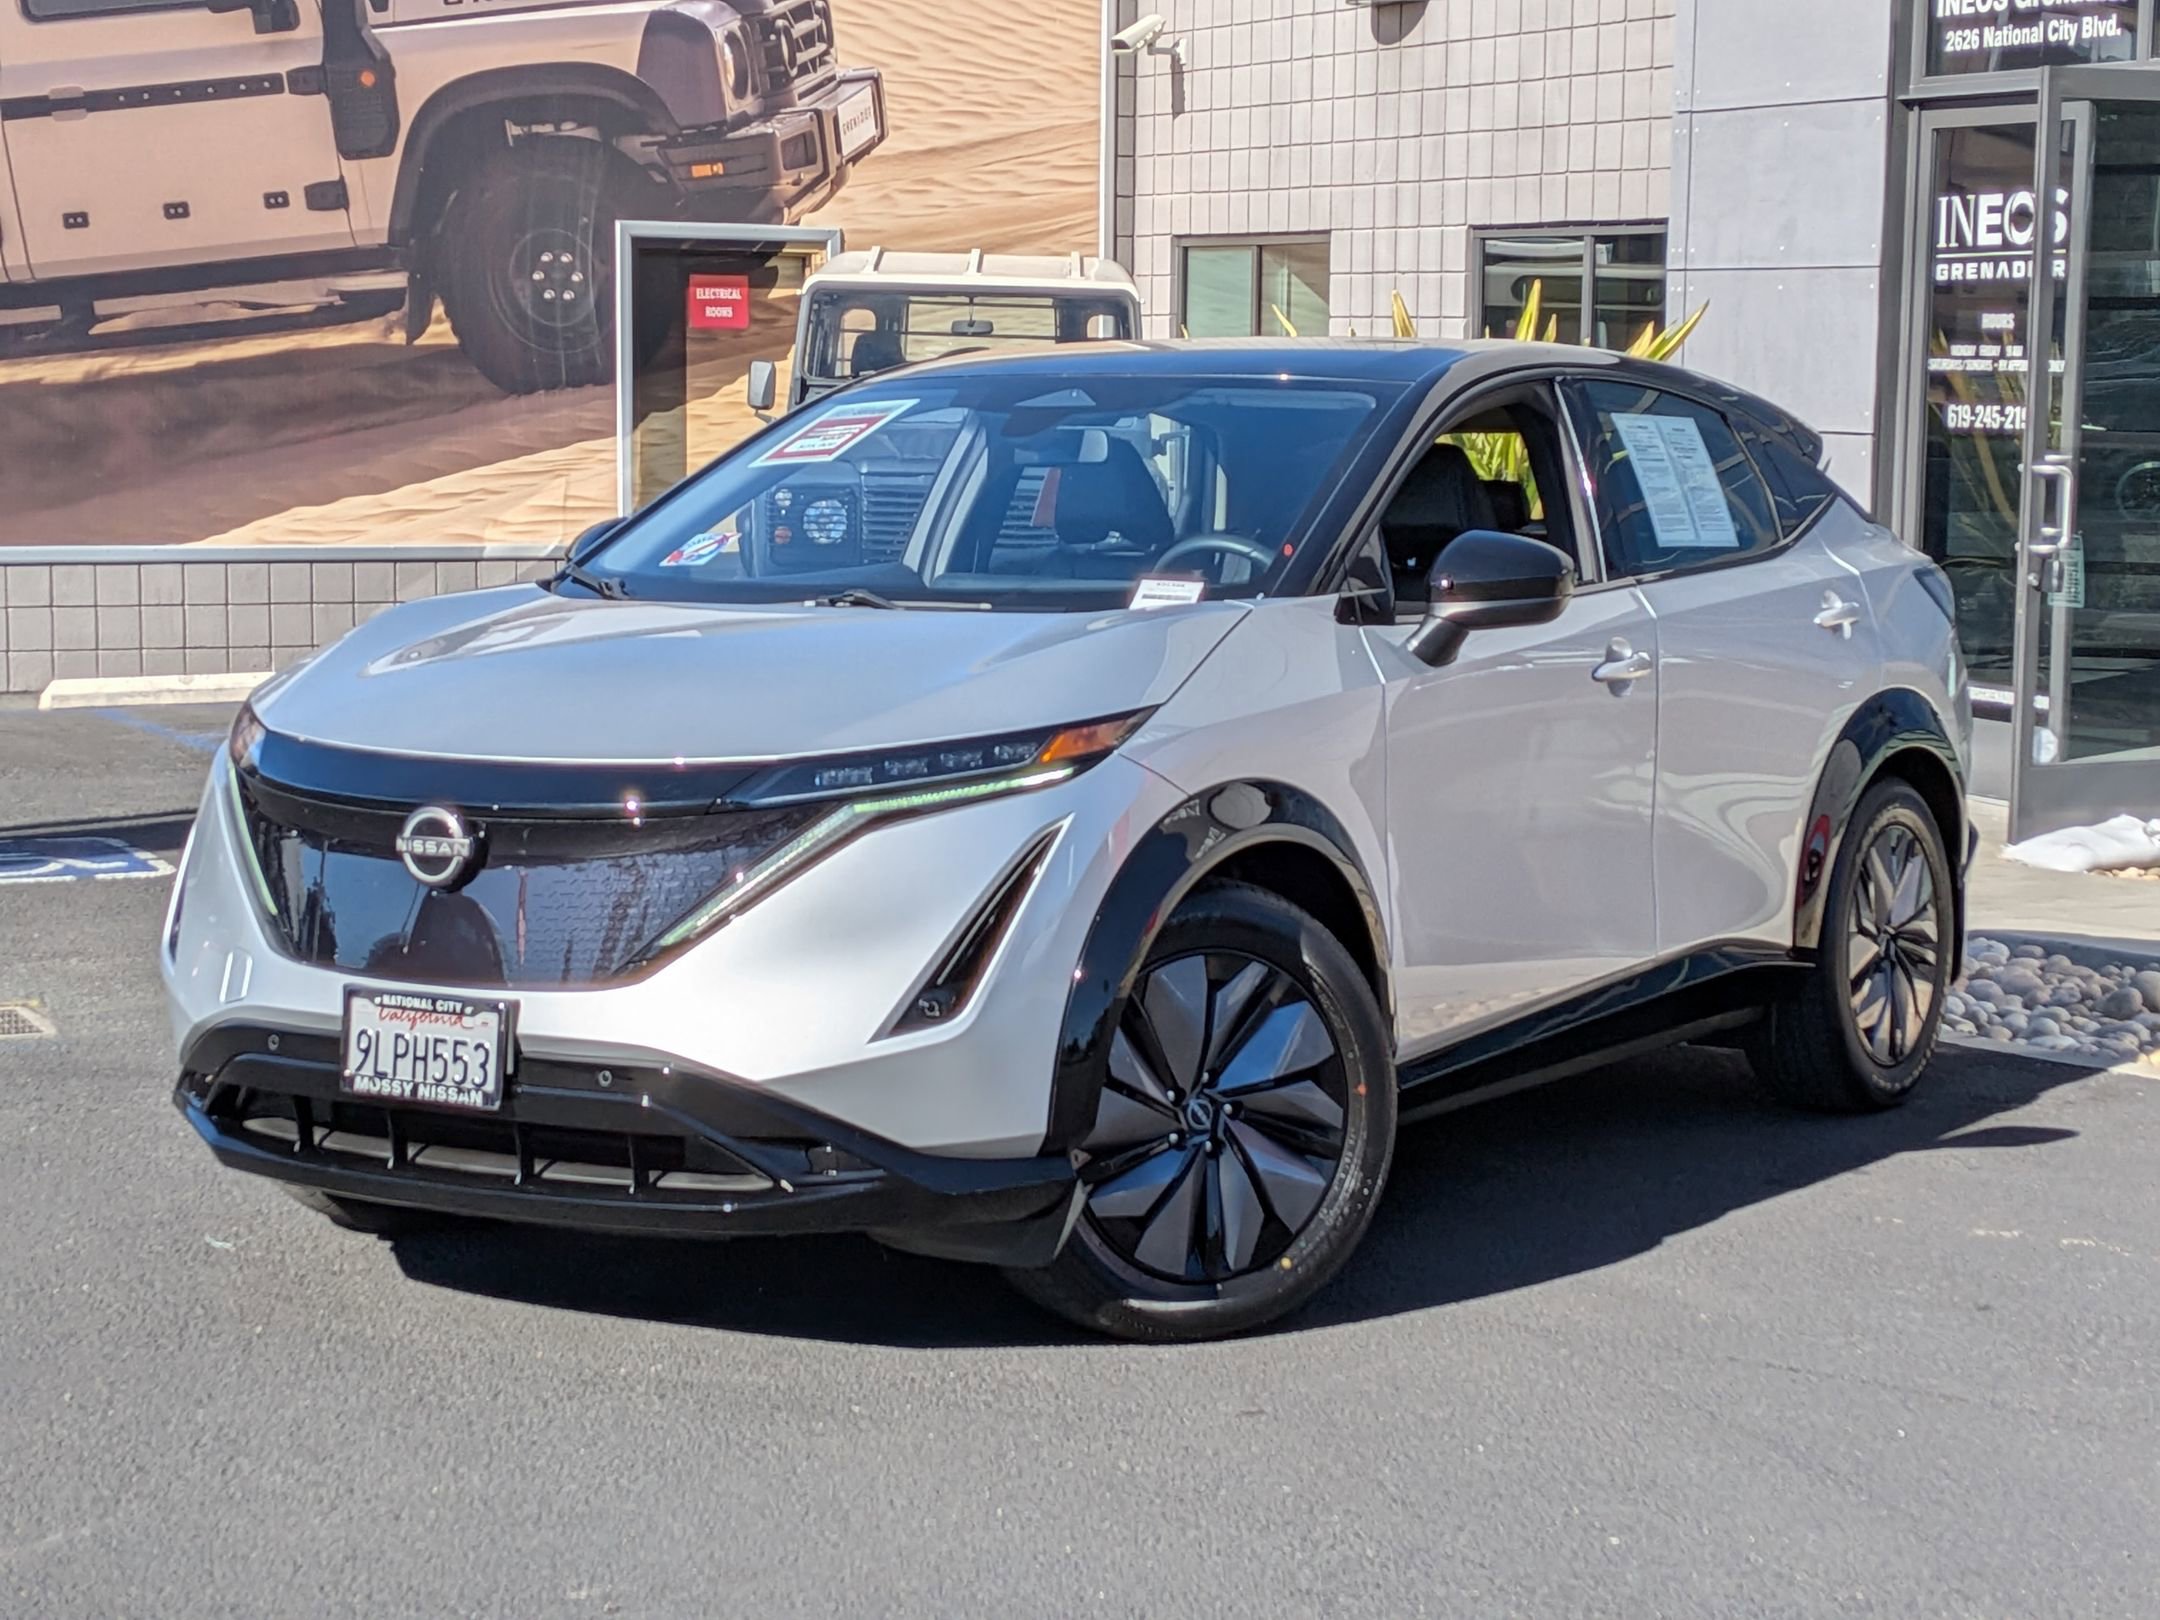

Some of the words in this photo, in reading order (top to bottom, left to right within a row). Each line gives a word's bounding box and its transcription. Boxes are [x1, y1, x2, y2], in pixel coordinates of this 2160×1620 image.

[1944, 28, 1980, 52] 2626
[1983, 21, 2044, 48] National
[2047, 18, 2078, 46] City
[2081, 14, 2121, 39] Blvd.
[1935, 259, 2067, 281] GRENADIR
[696, 287, 742, 300] ELECTRICAL
[395, 836, 471, 857] NISSAN
[382, 994, 434, 1010] NATIONAL
[435, 999, 463, 1013] CITY
[379, 1006, 473, 1031] California
[355, 1028, 491, 1088] 9LPH553
[353, 1075, 414, 1098] MOSSY
[417, 1083, 484, 1107] NISSAN
